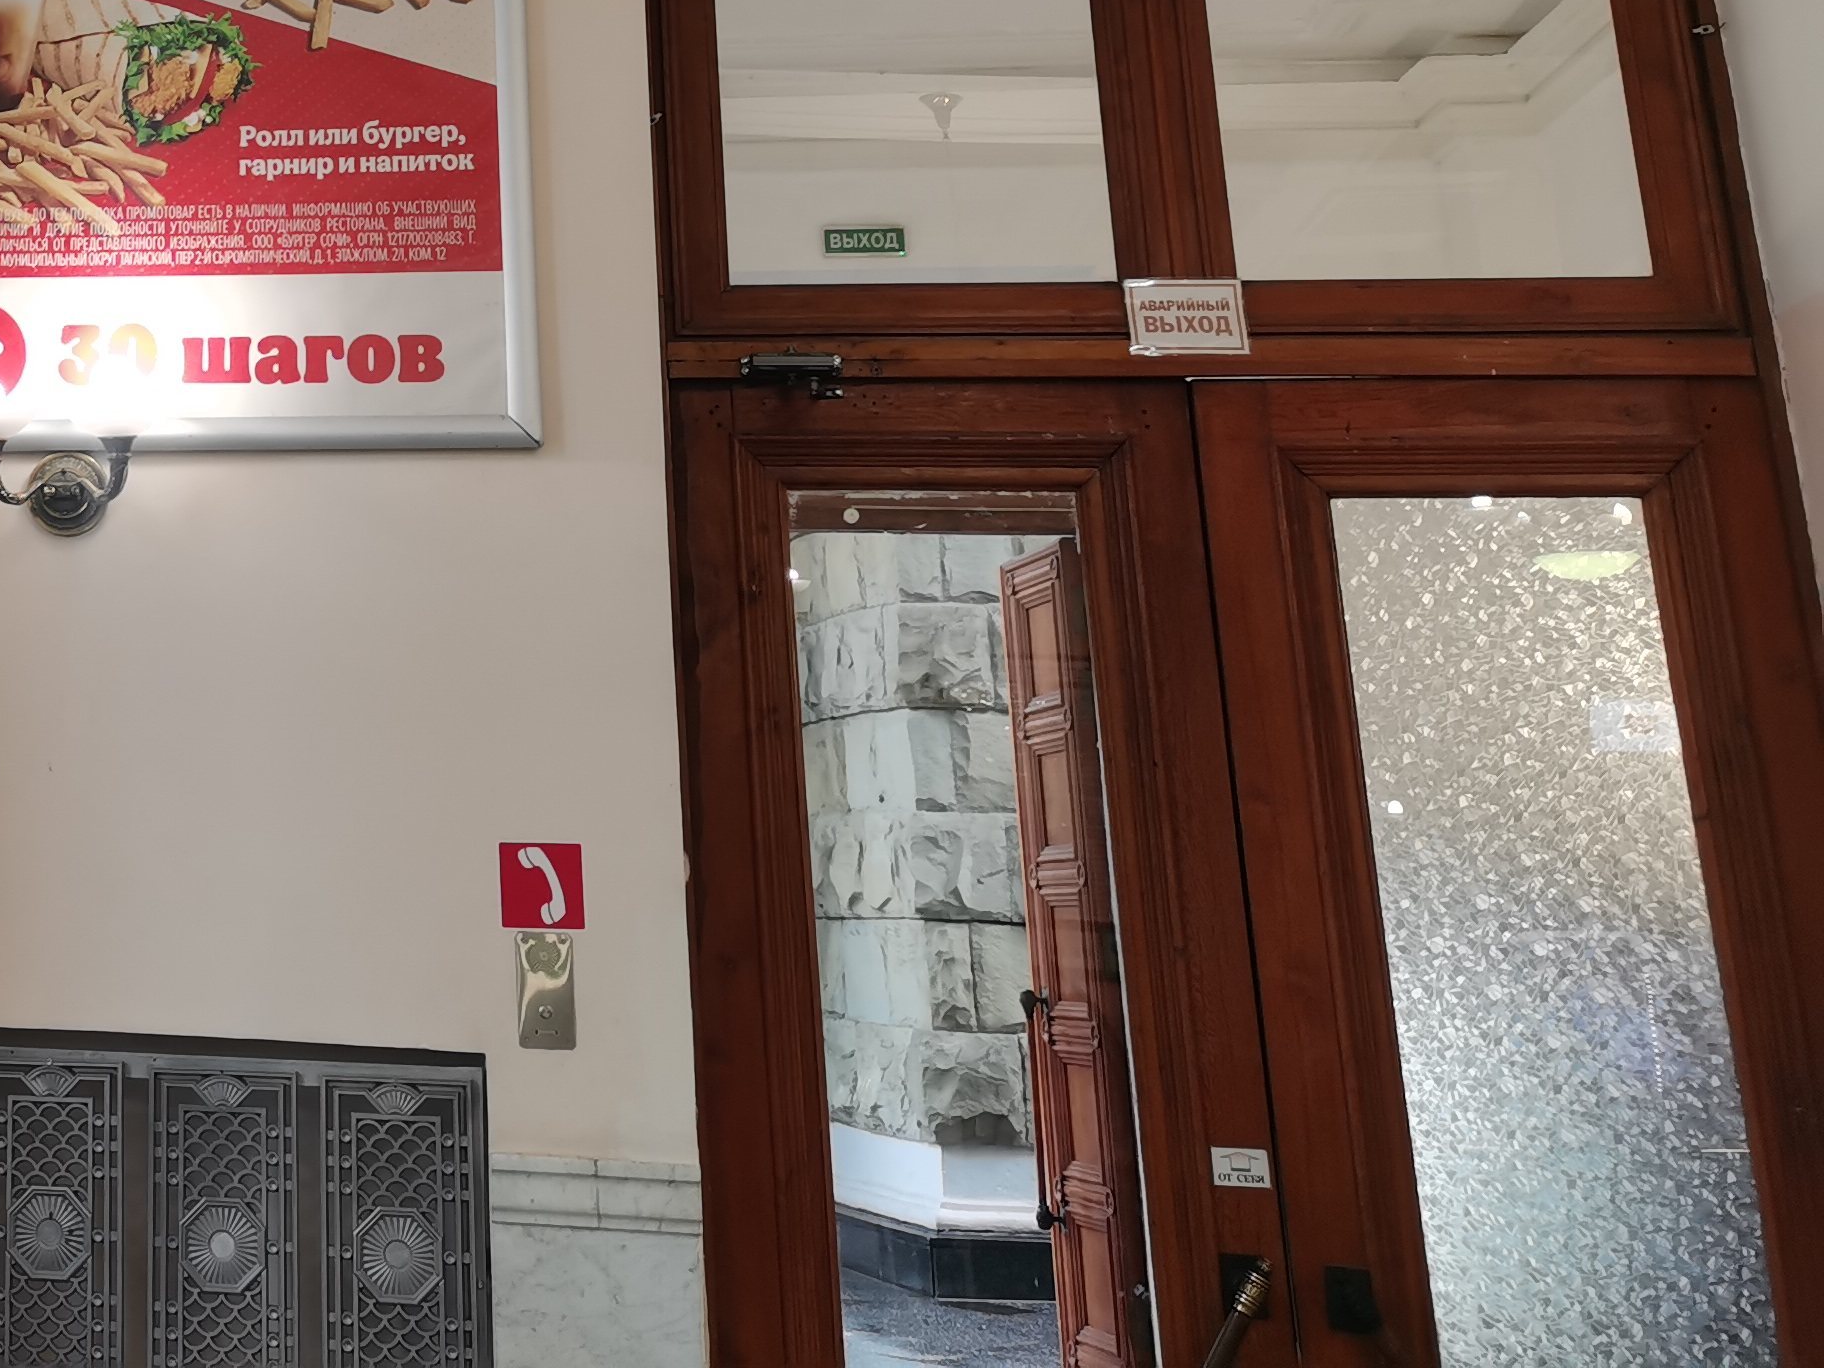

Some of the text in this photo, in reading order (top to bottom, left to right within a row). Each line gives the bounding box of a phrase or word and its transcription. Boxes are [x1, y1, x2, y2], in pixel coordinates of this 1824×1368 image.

[239, 120, 466, 149] Ролл или бургер,
[239, 153, 474, 181] гарнир и напиток
[32, 207, 46, 223] ДО
[126, 205, 195, 219] ПРОМОТОВАР
[198, 205, 223, 219] ЕСТЬ
[226, 204, 233, 218] В
[292, 202, 373, 217] ИНФОРМАЦИЮ
[376, 201, 390, 215] ОБ
[392, 200, 476, 214] УЧАСТВУЮЩИХ
[33, 222, 40, 236] И
[45, 222, 85, 237] ДРУГИЕ
[170, 219, 229, 234] УТОЧНЯЙТЕ
[233, 219, 241, 234] У
[246, 218, 321, 233] СОТРУДНИКОВ
[326, 216, 388, 232] РЕСТОРАНА.
[394, 214, 448, 230] ВНЕШНИЙ
[453, 215, 476, 230] ВИД
[53, 236, 65, 251] ОТ
[69, 236, 165, 252] ПРЕДСТАВЛЕННОГО
[170, 234, 247, 250] ИЗОБРАЖЕНИЯ.
[252, 234, 274, 248] ООО
[357, 232, 383, 246] ОГРН
[468, 230, 476, 244] Г.
[830, 232, 899, 249] ВЫХОД
[0, 251, 87, 267] МУНИЦИПАЛЬНЫЙ
[88, 252, 118, 267] ОКРУГ
[119, 250, 174, 267] ТАГАНСКИЙ,
[212, 248, 312, 266] СЫРОМЯТНИЧЕСКИЙ,
[435, 246, 446, 261] 12
[1139, 297, 1231, 312] АВАРИЙНЫЙ
[1143, 315, 1233, 336] ВЫХОД
[182, 334, 445, 384] шагов
[1218, 1172, 1232, 1182] ОТ
